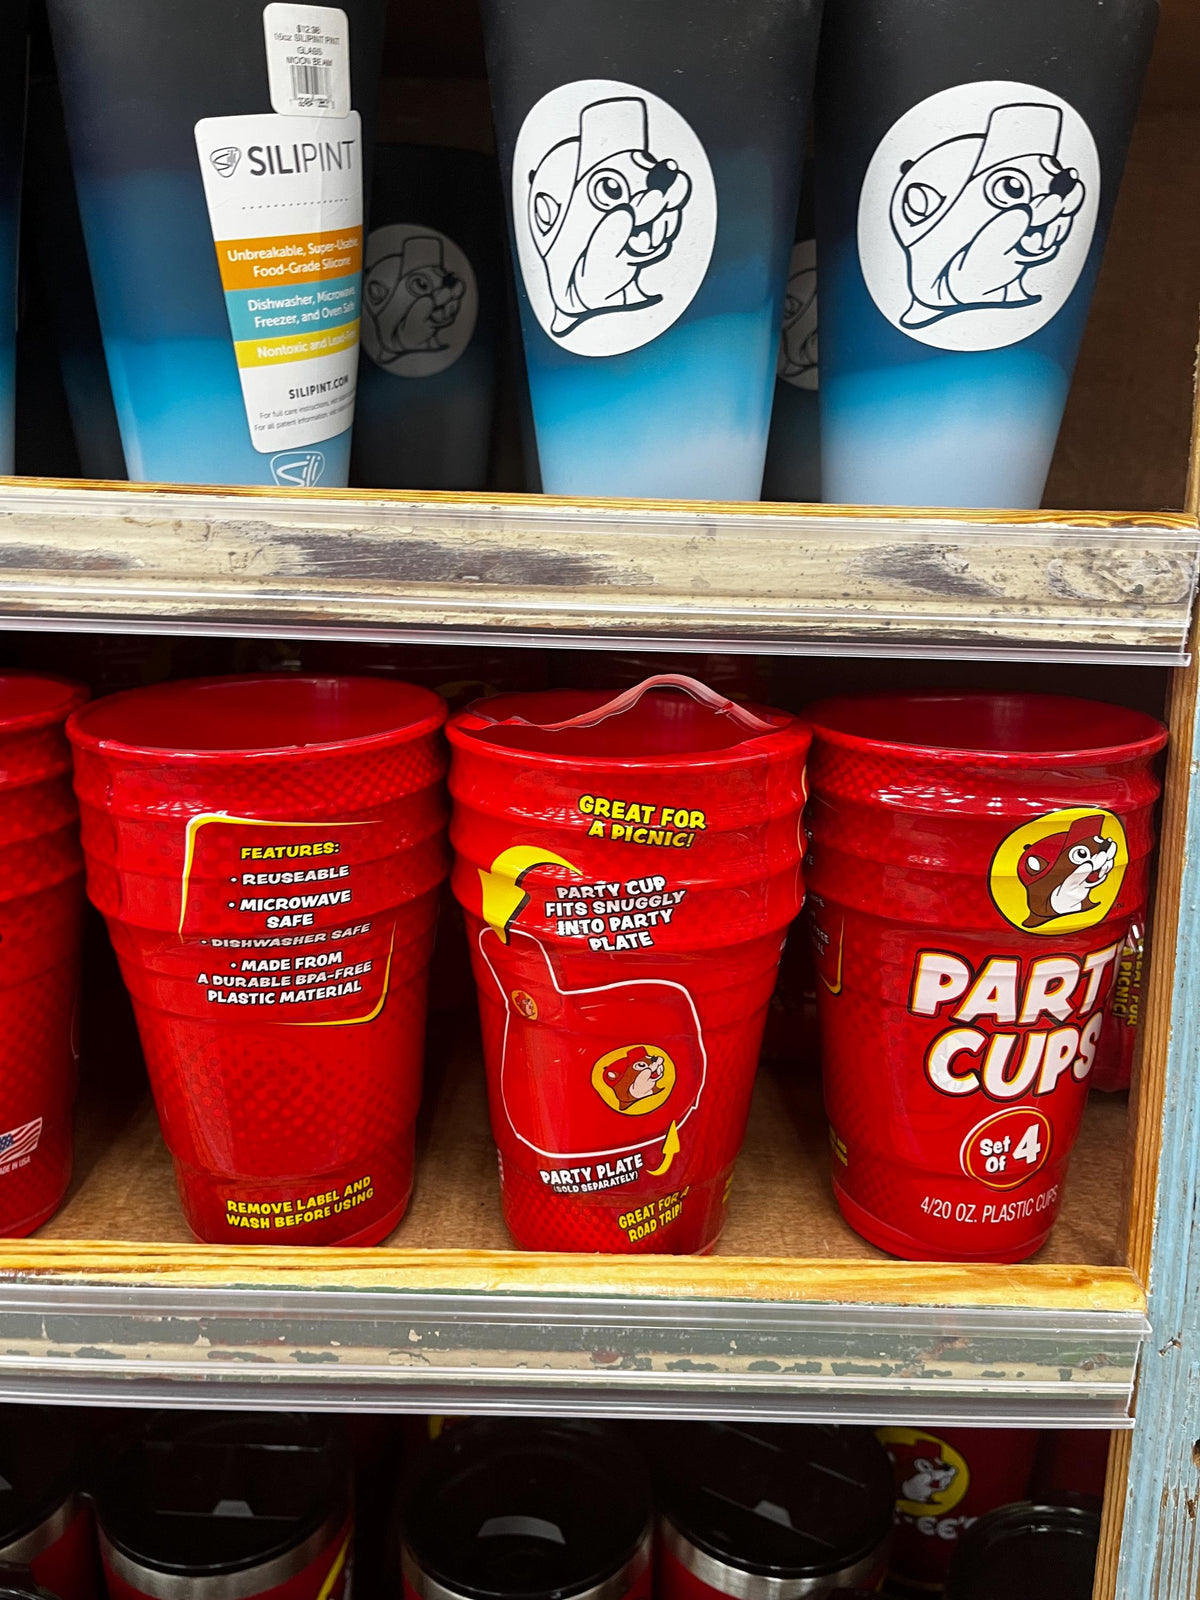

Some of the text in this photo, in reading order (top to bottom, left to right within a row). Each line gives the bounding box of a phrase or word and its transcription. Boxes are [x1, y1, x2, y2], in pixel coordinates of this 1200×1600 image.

[286, 56, 311, 65] MOON
[296, 46, 323, 56] GLASS
[247, 139, 355, 176] SILIPINT
[227, 245, 306, 262] Unbreakable,
[253, 256, 351, 278] Food-Grade Silicone
[247, 296, 315, 312] Dishwasher,
[254, 316, 299, 329] Freezer,
[301, 309, 321, 323] and
[321, 306, 342, 319] Oven
[257, 343, 308, 358] Nontoxic
[310, 338, 328, 351] and
[288, 374, 349, 400] SILIPINT.COM
[579, 795, 706, 830] GREAT FOR
[588, 820, 695, 848] A PICNIC!
[241, 841, 340, 860] FEATURES:
[242, 865, 350, 886] REUSEABLE
[556, 876, 667, 900] PARTY CUP
[239, 890, 351, 912] MICROWAVE
[545, 890, 687, 918] FITS SNUGGLY
[266, 913, 314, 930] SAFE
[557, 908, 674, 937] INTO PARTY
[211, 923, 371, 949] DISHWASHER SAFE
[588, 931, 655, 952] PLATE
[197, 961, 373, 989] A DURABLE BPA-FREE
[241, 952, 343, 973] MADE FROM
[207, 981, 362, 1006] PLASTIC MATERIAL
[926, 1011, 1104, 1099] CUPS
[979, 1136, 1011, 1157] Set
[985, 1123, 1042, 1174] Of 4
[540, 1153, 644, 1184] PARTY PLATE
[553, 1170, 639, 1194] (SOLD SEPARATELY)
[227, 1175, 372, 1216] REMOVE LABEL AND
[618, 1185, 690, 1230] GREAT FOR A
[920, 1184, 1060, 1224] 4/20 OZ. PLASTIC CUPS
[226, 1187, 374, 1230] WASH BEFORE USING
[628, 1203, 682, 1244] ROAD TRIP!
